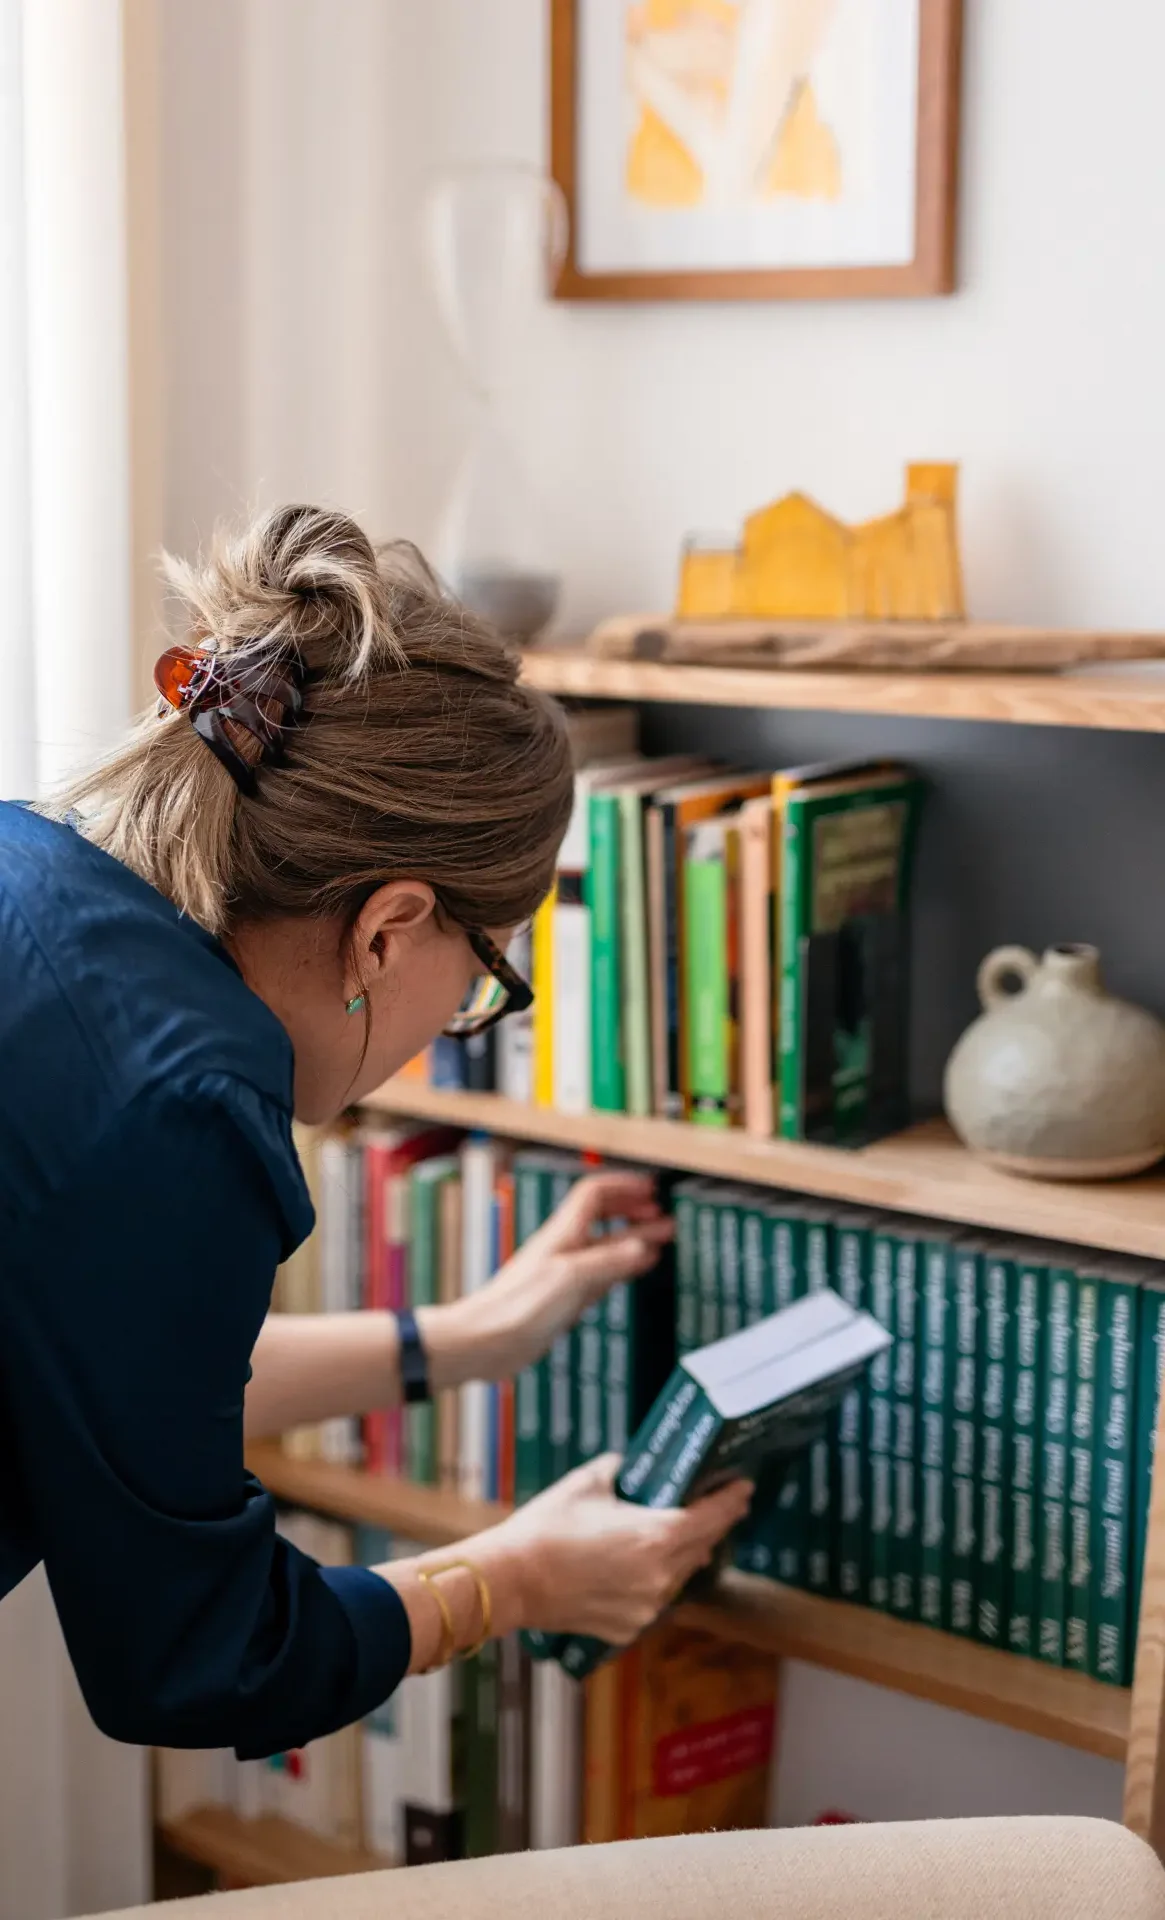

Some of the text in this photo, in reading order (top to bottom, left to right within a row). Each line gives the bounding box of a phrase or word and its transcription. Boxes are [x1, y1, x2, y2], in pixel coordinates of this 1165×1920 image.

[922, 1252, 949, 1346] completas
[953, 1260, 980, 1354] completas
[984, 1266, 1010, 1359] completas
[1015, 1272, 1041, 1367] completas
[1046, 1280, 1072, 1375] completas
[1074, 1283, 1100, 1380] completas
[922, 1347, 945, 1404] Obras
[1106, 1294, 1133, 1390] completas
[648, 1382, 697, 1454] completas
[953, 1357, 975, 1412] Obras
[983, 1363, 1005, 1418] Obras
[1013, 1370, 1036, 1425] Obras
[1043, 1377, 1068, 1434] Obras
[1071, 1382, 1095, 1438] Obras
[669, 1411, 715, 1483] completas
[922, 1410, 944, 1466] Freud
[952, 1419, 974, 1475] Freud
[982, 1426, 1003, 1482] Freud
[1104, 1393, 1127, 1449] Obras
[1012, 1433, 1034, 1490] Freud
[1042, 1440, 1065, 1499] Freud
[1069, 1446, 1092, 1504] Freud
[1101, 1457, 1124, 1516] Freud
[921, 1468, 945, 1547] Sigmund
[952, 1477, 976, 1556] Sigmund
[981, 1485, 1004, 1563] Sigmund
[1011, 1492, 1035, 1571] Sigmund
[1041, 1501, 1066, 1581] Sigmund
[1068, 1505, 1093, 1588] Sigmund
[1099, 1516, 1125, 1599] Sigmund
